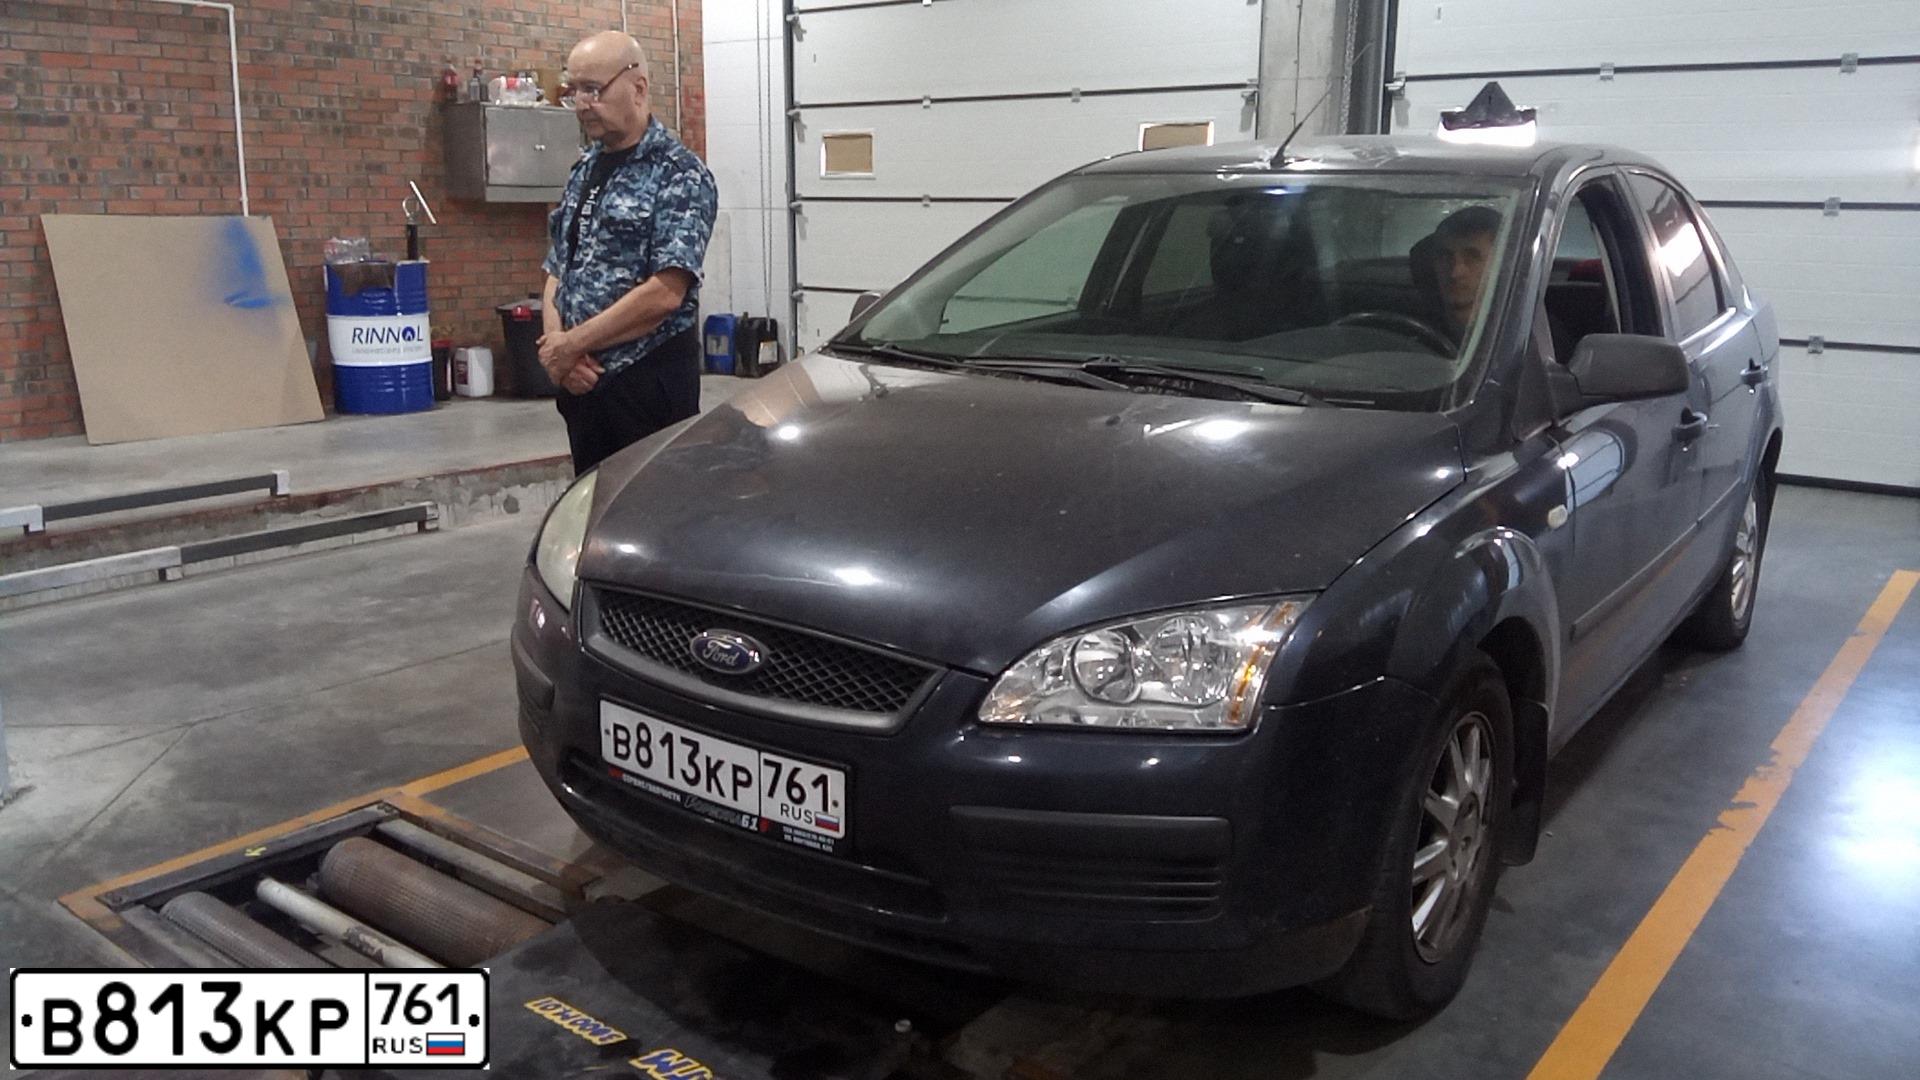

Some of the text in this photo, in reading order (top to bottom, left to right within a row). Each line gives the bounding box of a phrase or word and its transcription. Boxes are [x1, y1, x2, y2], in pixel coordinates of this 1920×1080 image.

[352, 325, 424, 344] RINNOL
[702, 640, 741, 666] Ford
[763, 758, 829, 812] 761
[780, 803, 813, 824] RUS
